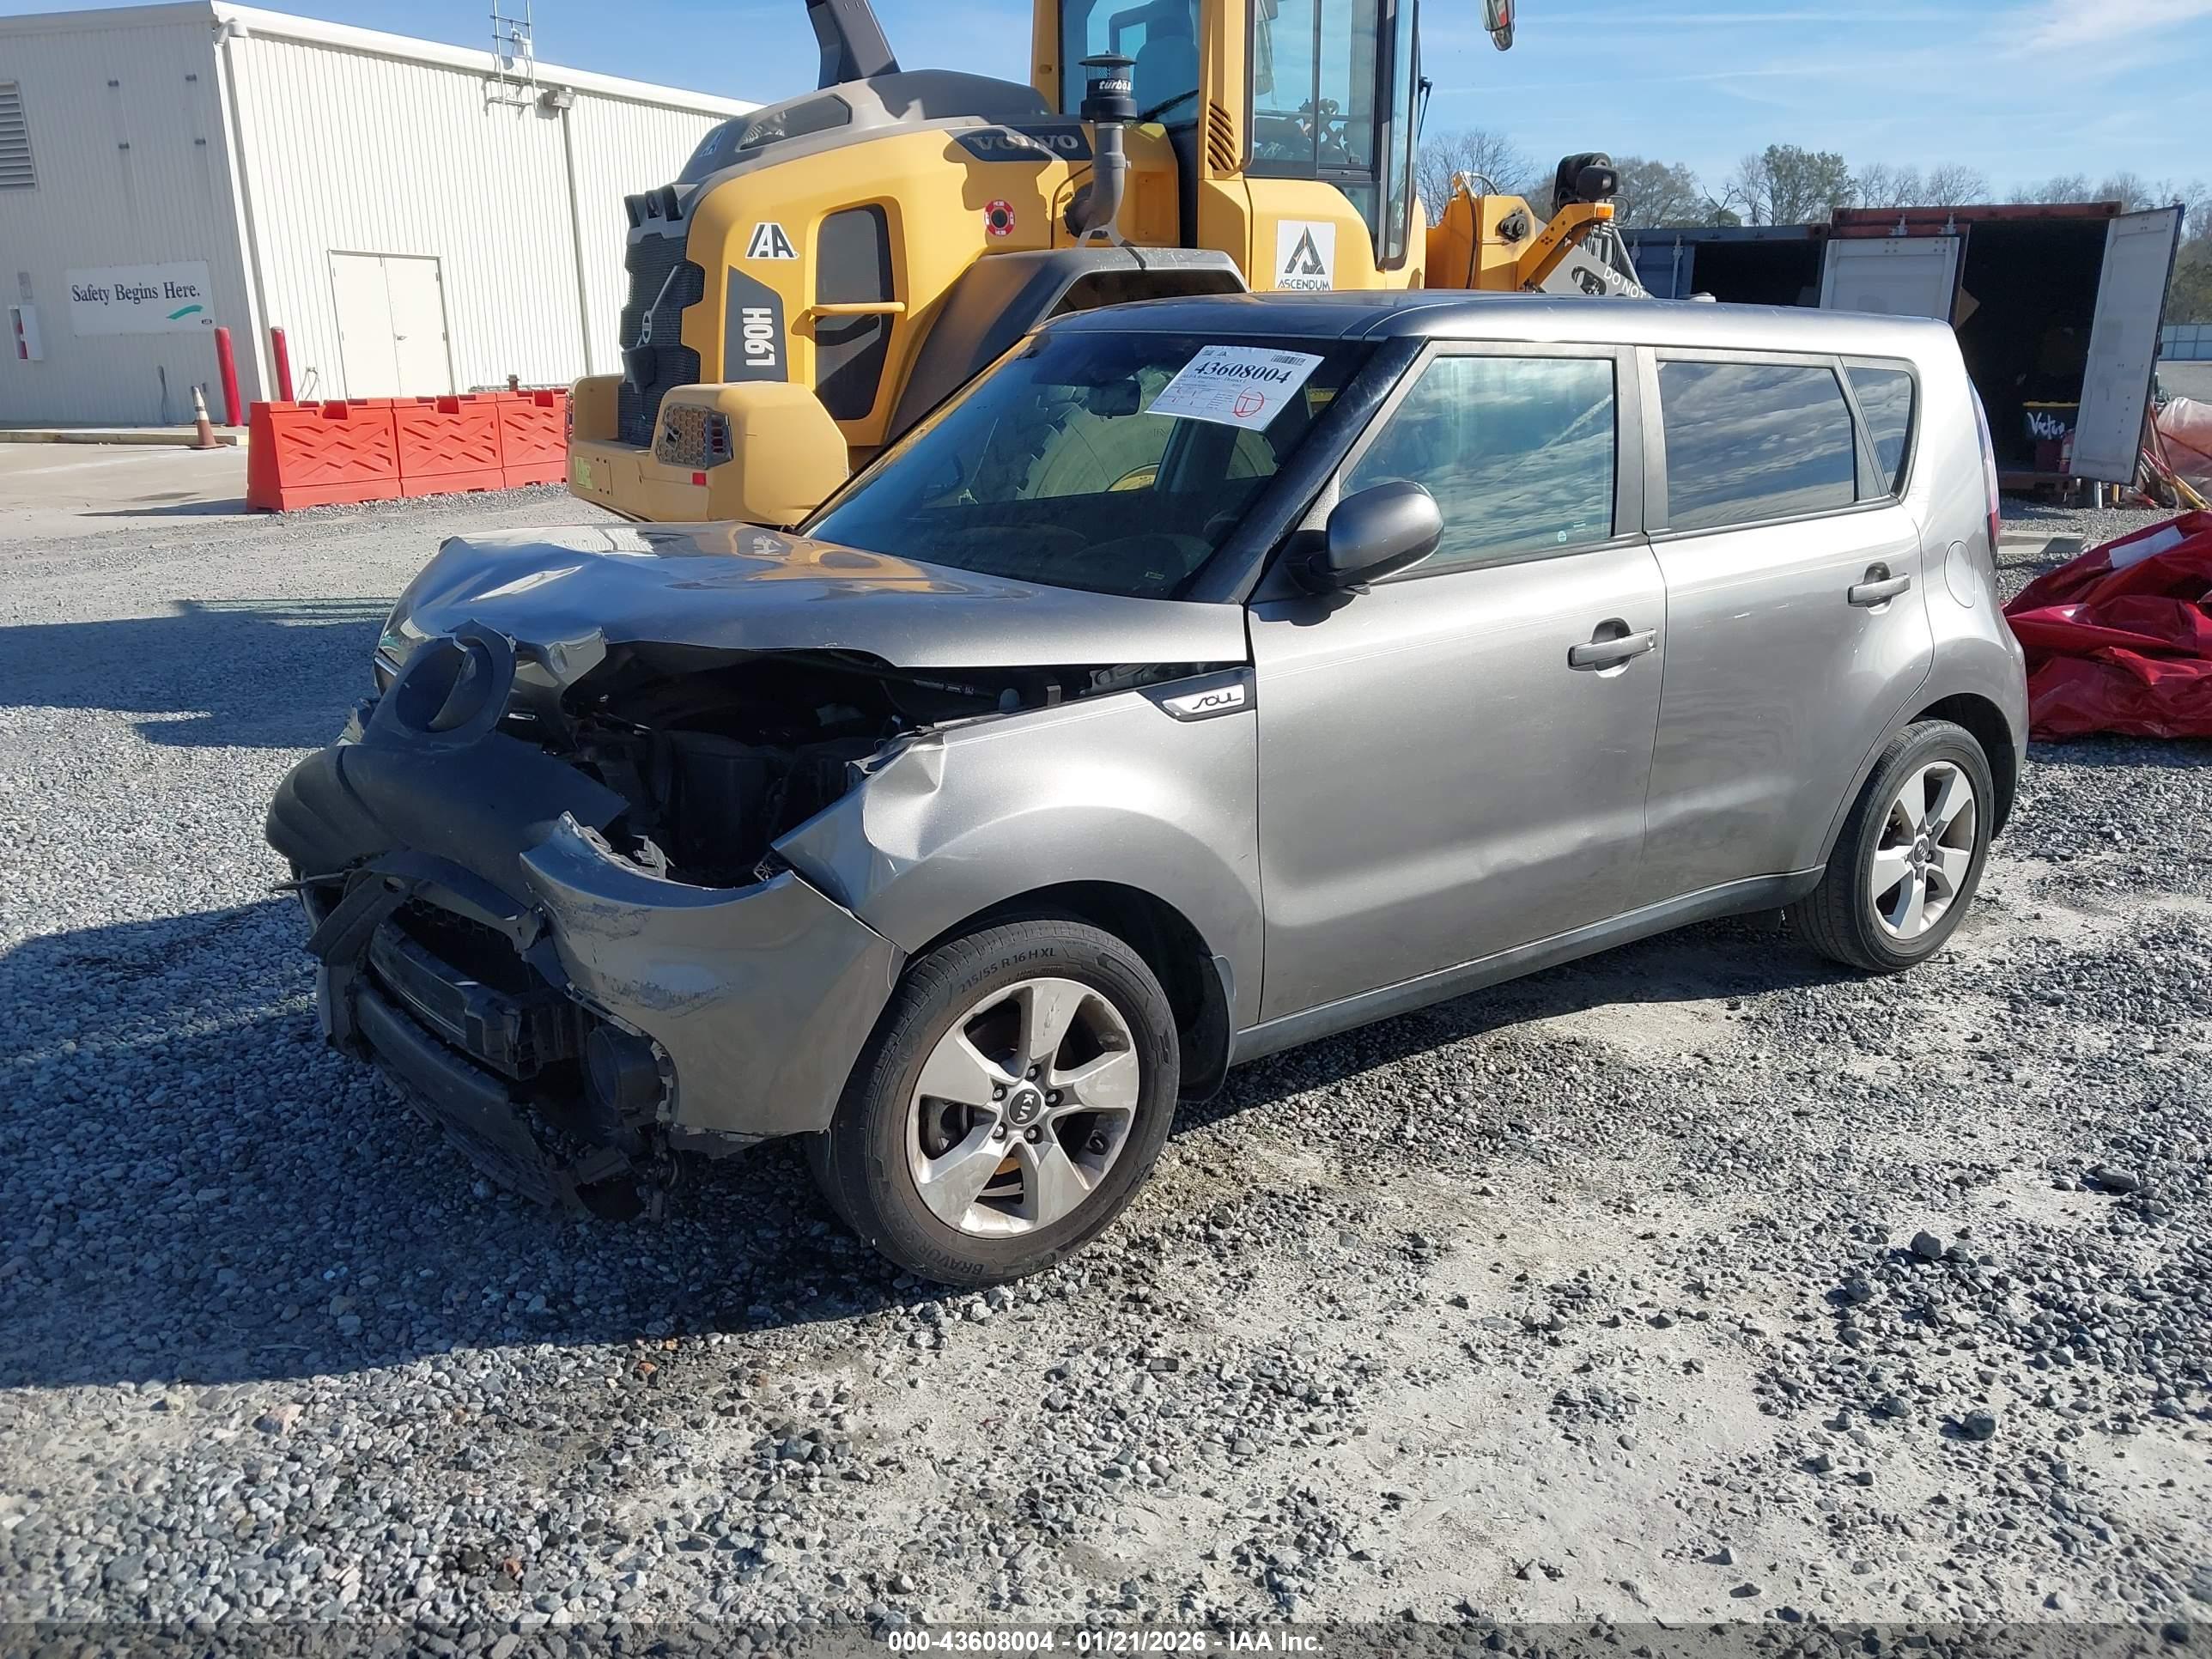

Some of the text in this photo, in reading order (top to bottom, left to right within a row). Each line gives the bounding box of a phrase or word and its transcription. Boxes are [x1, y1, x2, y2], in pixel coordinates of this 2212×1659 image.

[968, 135, 1079, 150] VOLVO
[1278, 279, 1331, 290] ASCENDUM
[1603, 265, 1647, 298] DO NOT
[71, 282, 200, 306] Safety Begins Here.
[742, 307, 776, 367] L90H
[1194, 361, 1293, 384] 43608004
[1192, 692, 1242, 710] SOUL
[960, 947, 1056, 994] 215/55 R 16 H XL
[1017, 1093, 1035, 1121] KIA
